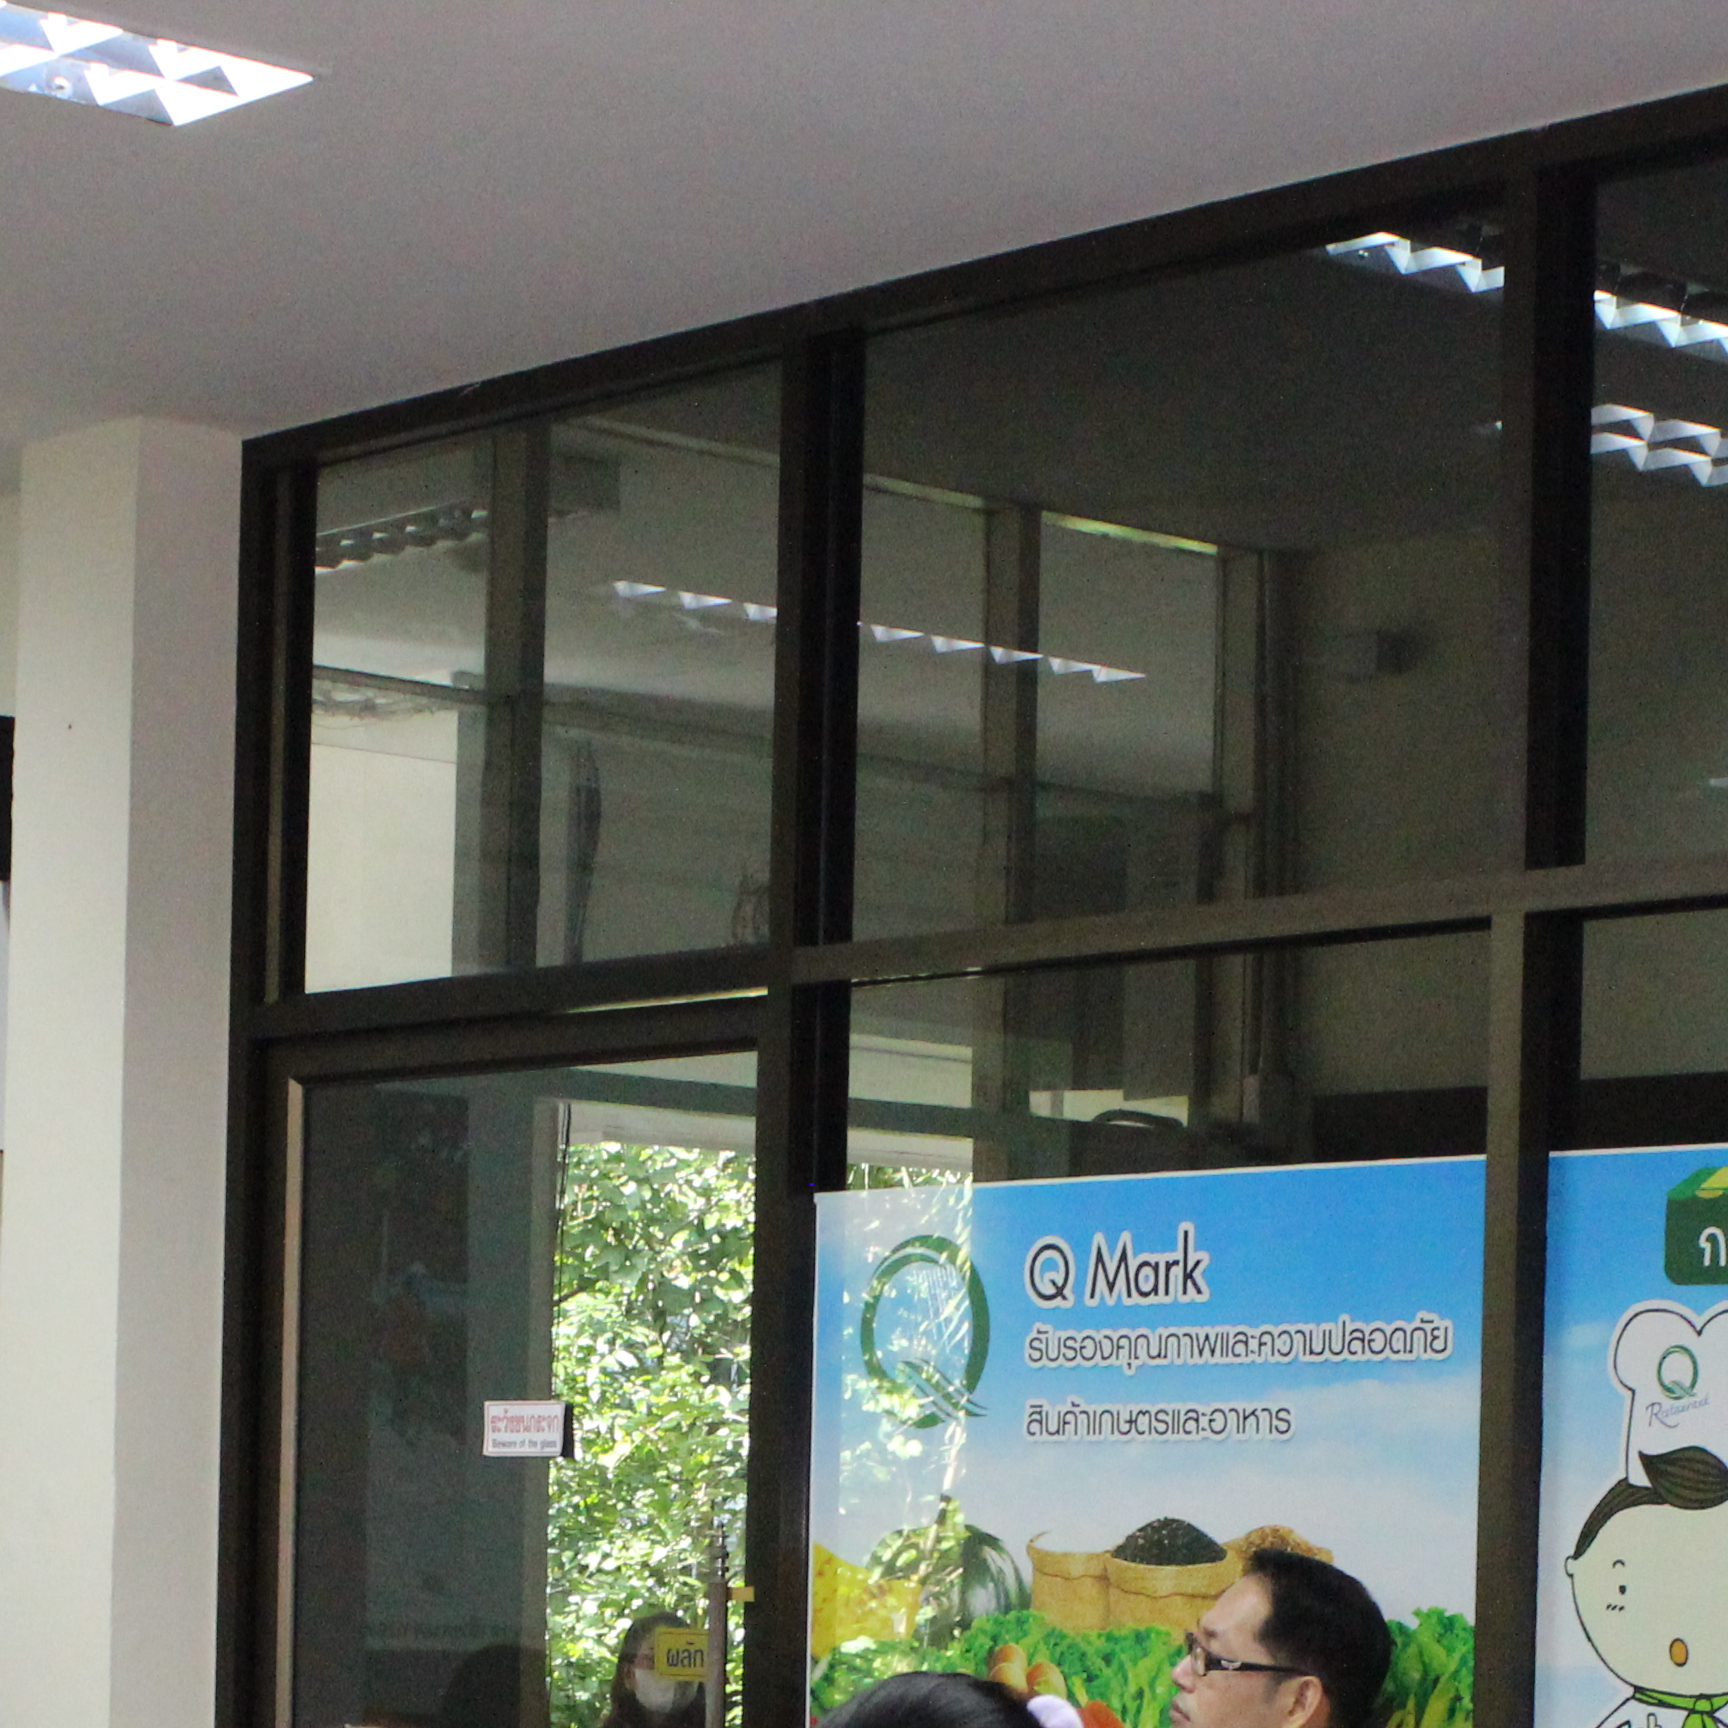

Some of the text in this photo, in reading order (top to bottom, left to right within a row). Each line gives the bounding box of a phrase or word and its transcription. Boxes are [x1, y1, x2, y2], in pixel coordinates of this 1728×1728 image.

[1028, 1229, 1207, 1301] Q Mark
[1027, 1319, 1450, 1371] รับรองคุณภาพและความปลอดภัย
[1026, 1401, 1292, 1437] สินค้าเกษตรและอาหาร
